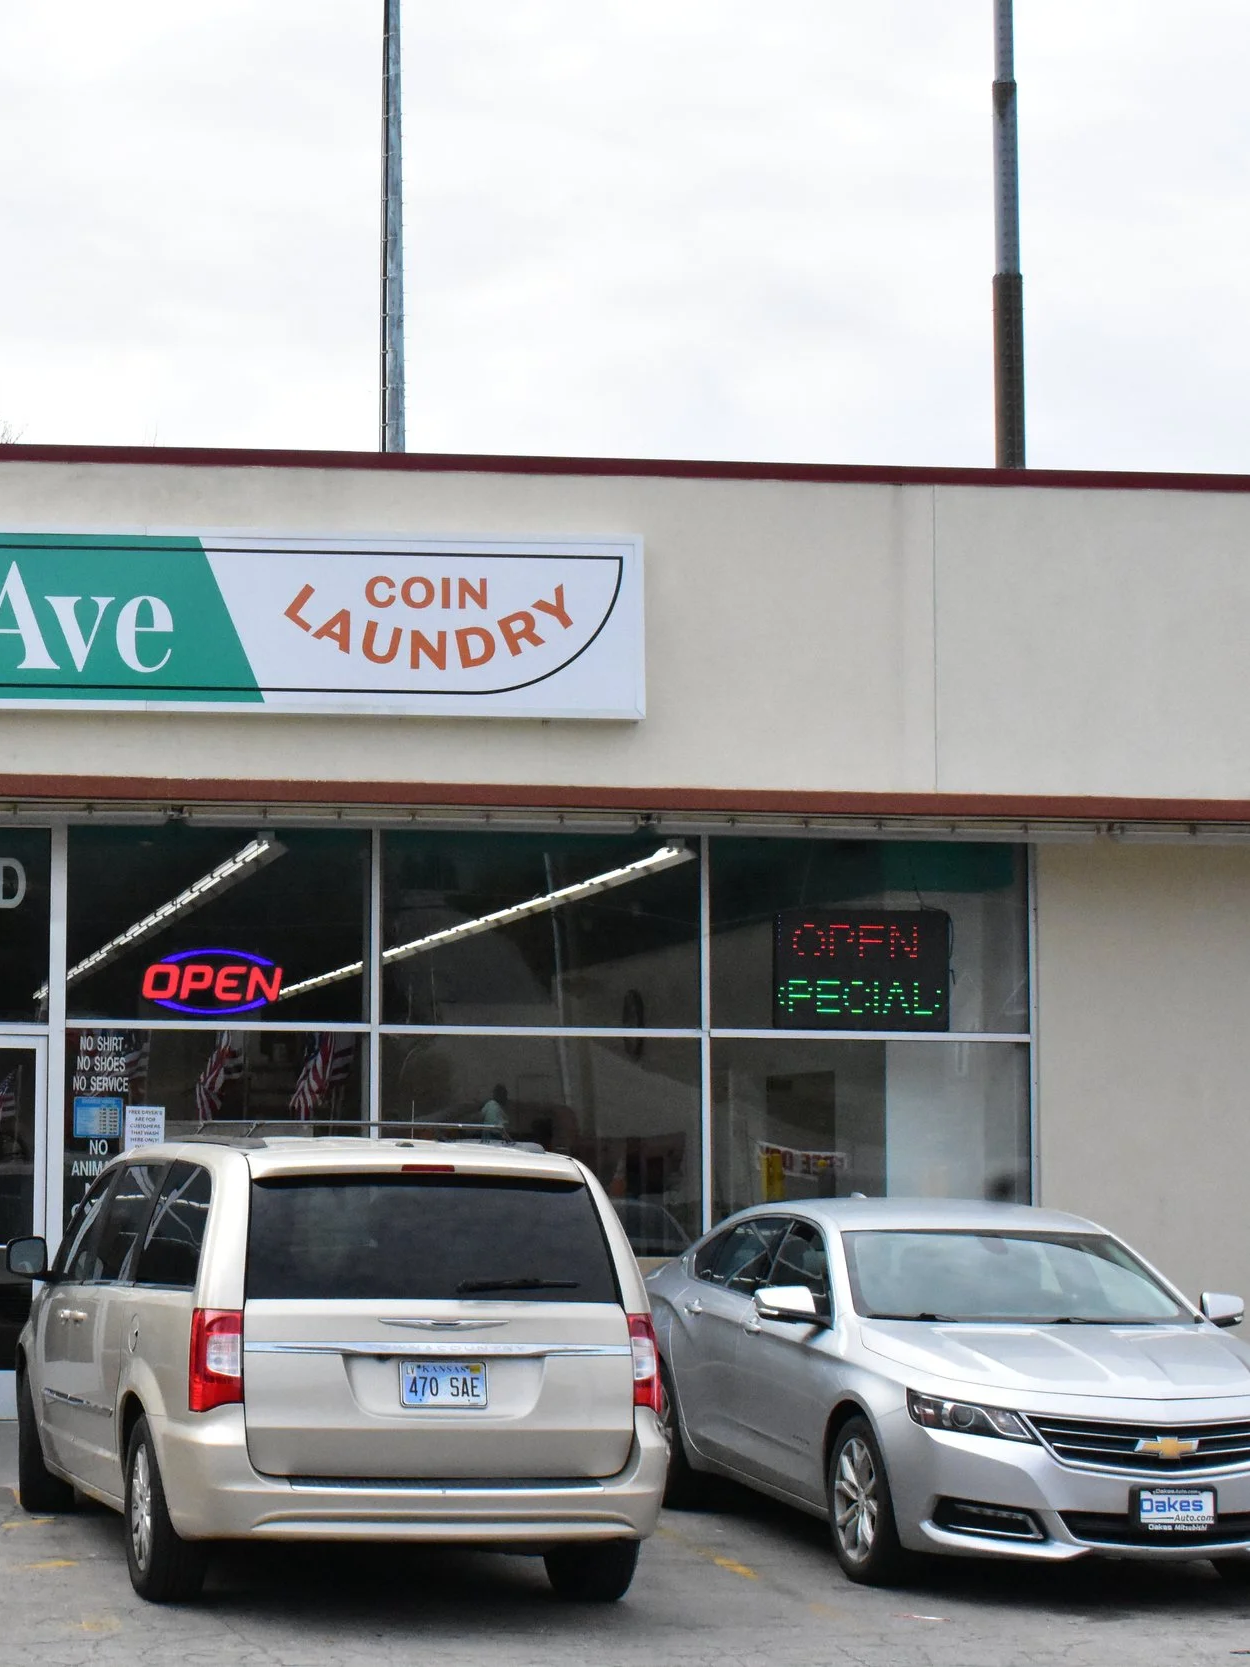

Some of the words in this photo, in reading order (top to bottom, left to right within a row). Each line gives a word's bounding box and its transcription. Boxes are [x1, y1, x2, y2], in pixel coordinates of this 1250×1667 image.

[364, 575, 488, 610] COIN
[283, 583, 574, 671] LAUNDRY
[792, 924, 919, 958] OPEN
[141, 963, 283, 1003] OPEN
[79, 1036, 93, 1051] NO
[97, 1036, 124, 1052] SHIRT
[76, 1055, 90, 1071] NO
[94, 1056, 126, 1073] SHOES
[72, 1076, 87, 1091] NO
[90, 1076, 129, 1093] SERVICE
[90, 1139, 108, 1155] NO
[71, 1160, 110, 1176] ANIM
[421, 1365, 468, 1373] KANSAS
[409, 1376, 439, 1397] 470
[450, 1377, 480, 1397] SAE
[1140, 1497, 1203, 1512] Oakes
